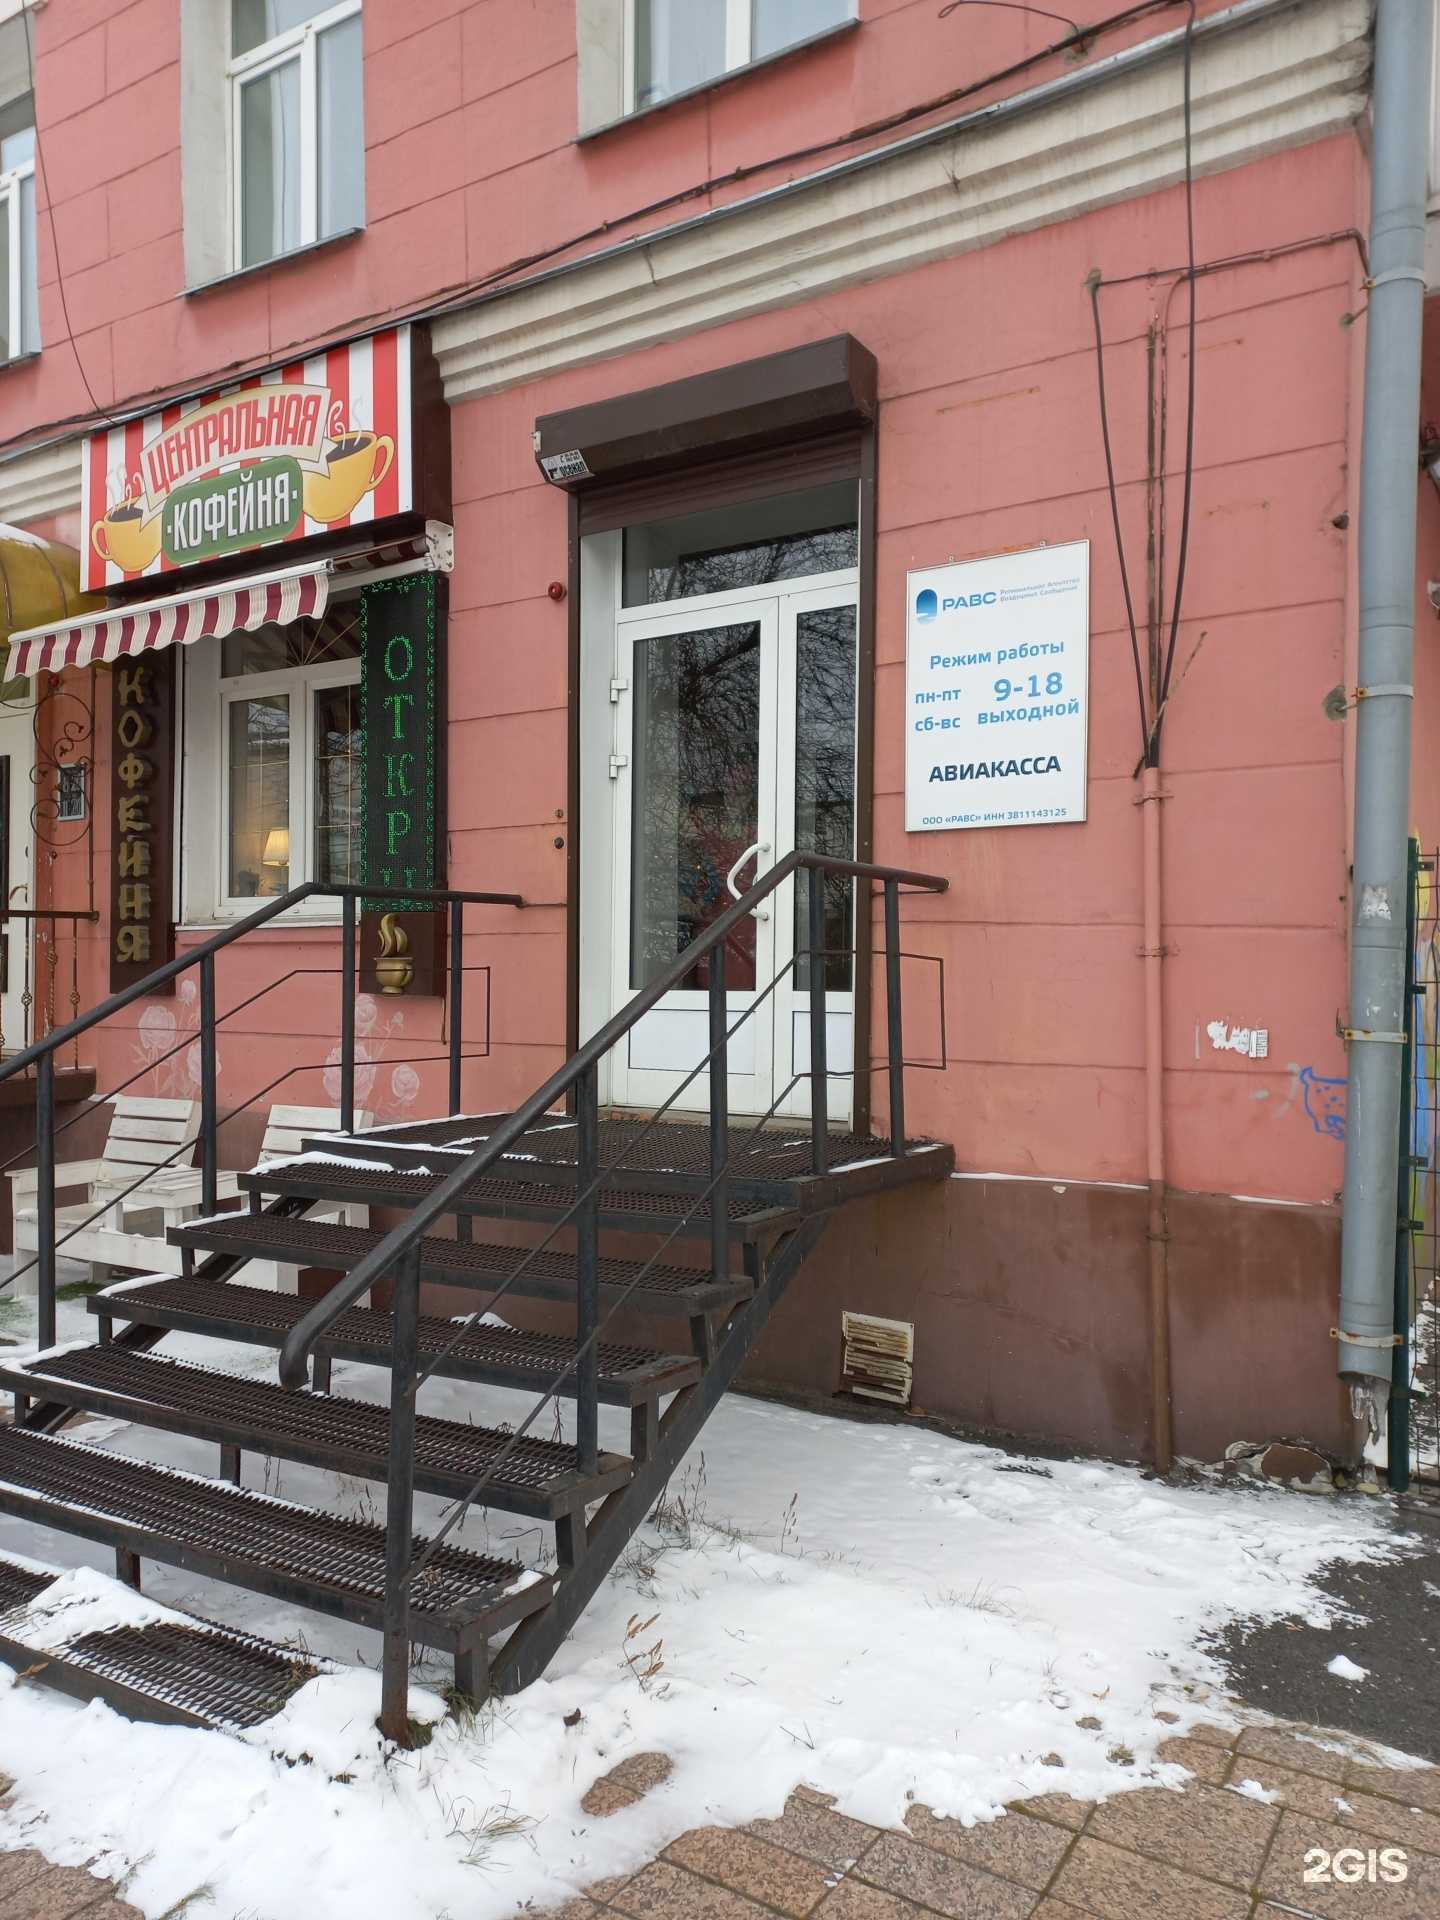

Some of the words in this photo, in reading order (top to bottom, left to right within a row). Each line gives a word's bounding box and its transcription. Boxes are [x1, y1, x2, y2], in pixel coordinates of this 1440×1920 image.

[145, 394, 322, 496] ЦЕНТРАЛЬНАЯ
[173, 470, 290, 552] КОФЕЙНЯ
[942, 591, 998, 611] РАВС
[930, 651, 992, 670] Режим
[997, 640, 1065, 665] работы
[915, 688, 962, 704] пн-пт
[993, 671, 1064, 701] 9-18
[914, 715, 961, 732] сб-вс
[977, 698, 1080, 725] выходной
[929, 755, 1061, 783] АВИАКАССА
[116, 666, 151, 963] КОФЕЙНЯ
[922, 816, 943, 825] ООО
[984, 813, 1005, 822] ИНН
[1007, 808, 1068, 820] 3811143125
